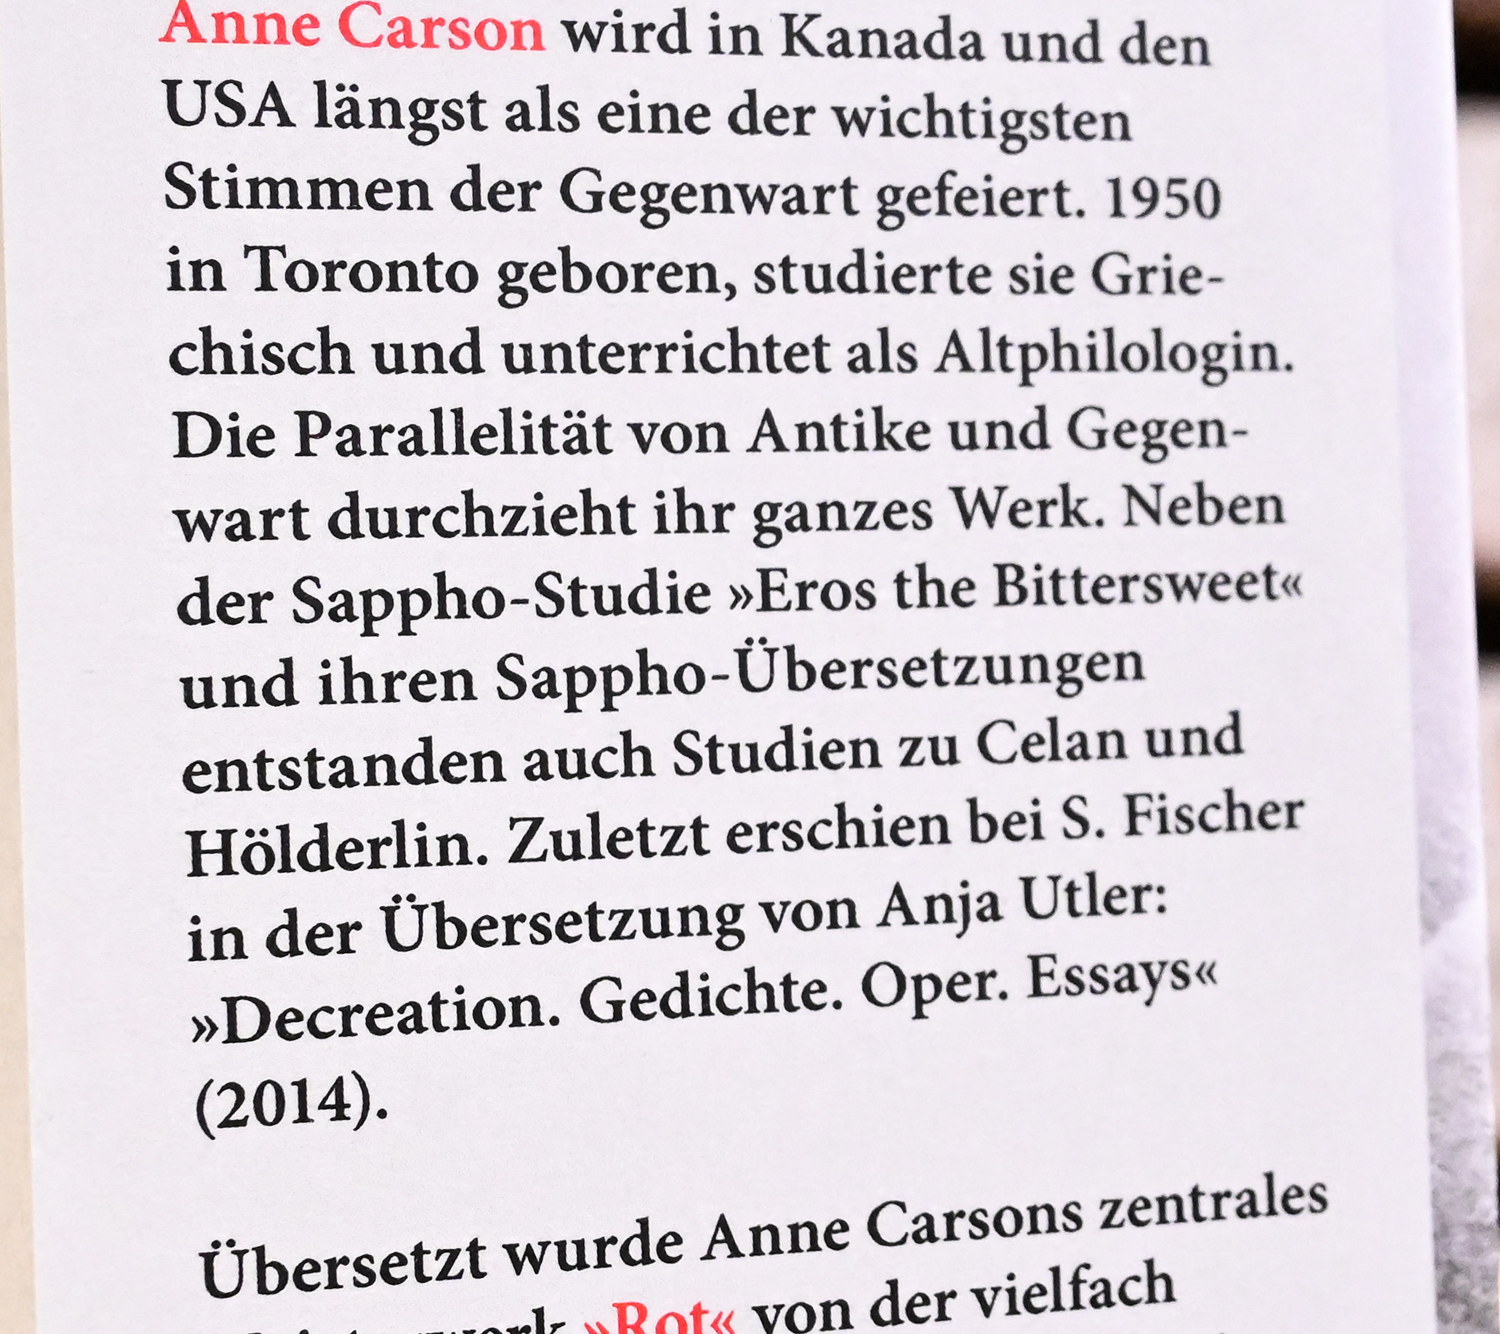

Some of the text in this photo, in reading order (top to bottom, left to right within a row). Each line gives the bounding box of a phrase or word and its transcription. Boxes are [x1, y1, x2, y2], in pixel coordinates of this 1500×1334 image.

[558, 5, 694, 56] wird
[706, 9, 765, 58] in
[777, 11, 988, 64] Kanada
[999, 17, 1106, 66] und
[1118, 18, 1213, 68] den
[159, 77, 1134, 157] USA längst als eine der wichtigsten
[163, 159, 1223, 233] Stimmen der Gegenwart gefeiert. 1950
[164, 242, 1225, 311] in Toronto geboren, studierte sie Grie-
[167, 323, 1295, 389] chisch und unterrichtet als Altphilologin.
[170, 402, 1250, 466] Die Parallelität von Antike und Gegen-
[170, 478, 1288, 551] wart durchzieht ihr ganzes Werk. Neben
[175, 560, 1304, 639] der Sappho-Studie »Eros the Bittersweet«
[177, 635, 1147, 715] und ihren Sappho-Übersetzungen
[180, 708, 1247, 796] entstanden auch Studien zu Celan und
[183, 785, 1307, 879] Hölderlin. Zuletzt erschien bei S. Fischer
[186, 868, 1168, 964] in der Übersetzung von Anja Utler:
[190, 952, 1219, 1046] »Decreation. Gedichte. Oper. Essays«
[194, 1068, 389, 1142] (2014).
[196, 1169, 1330, 1301] Übersetzt wurde Anne Carsons zentrales
[868, 1276, 959, 1329] der
[968, 1256, 1179, 1321] vielfach
